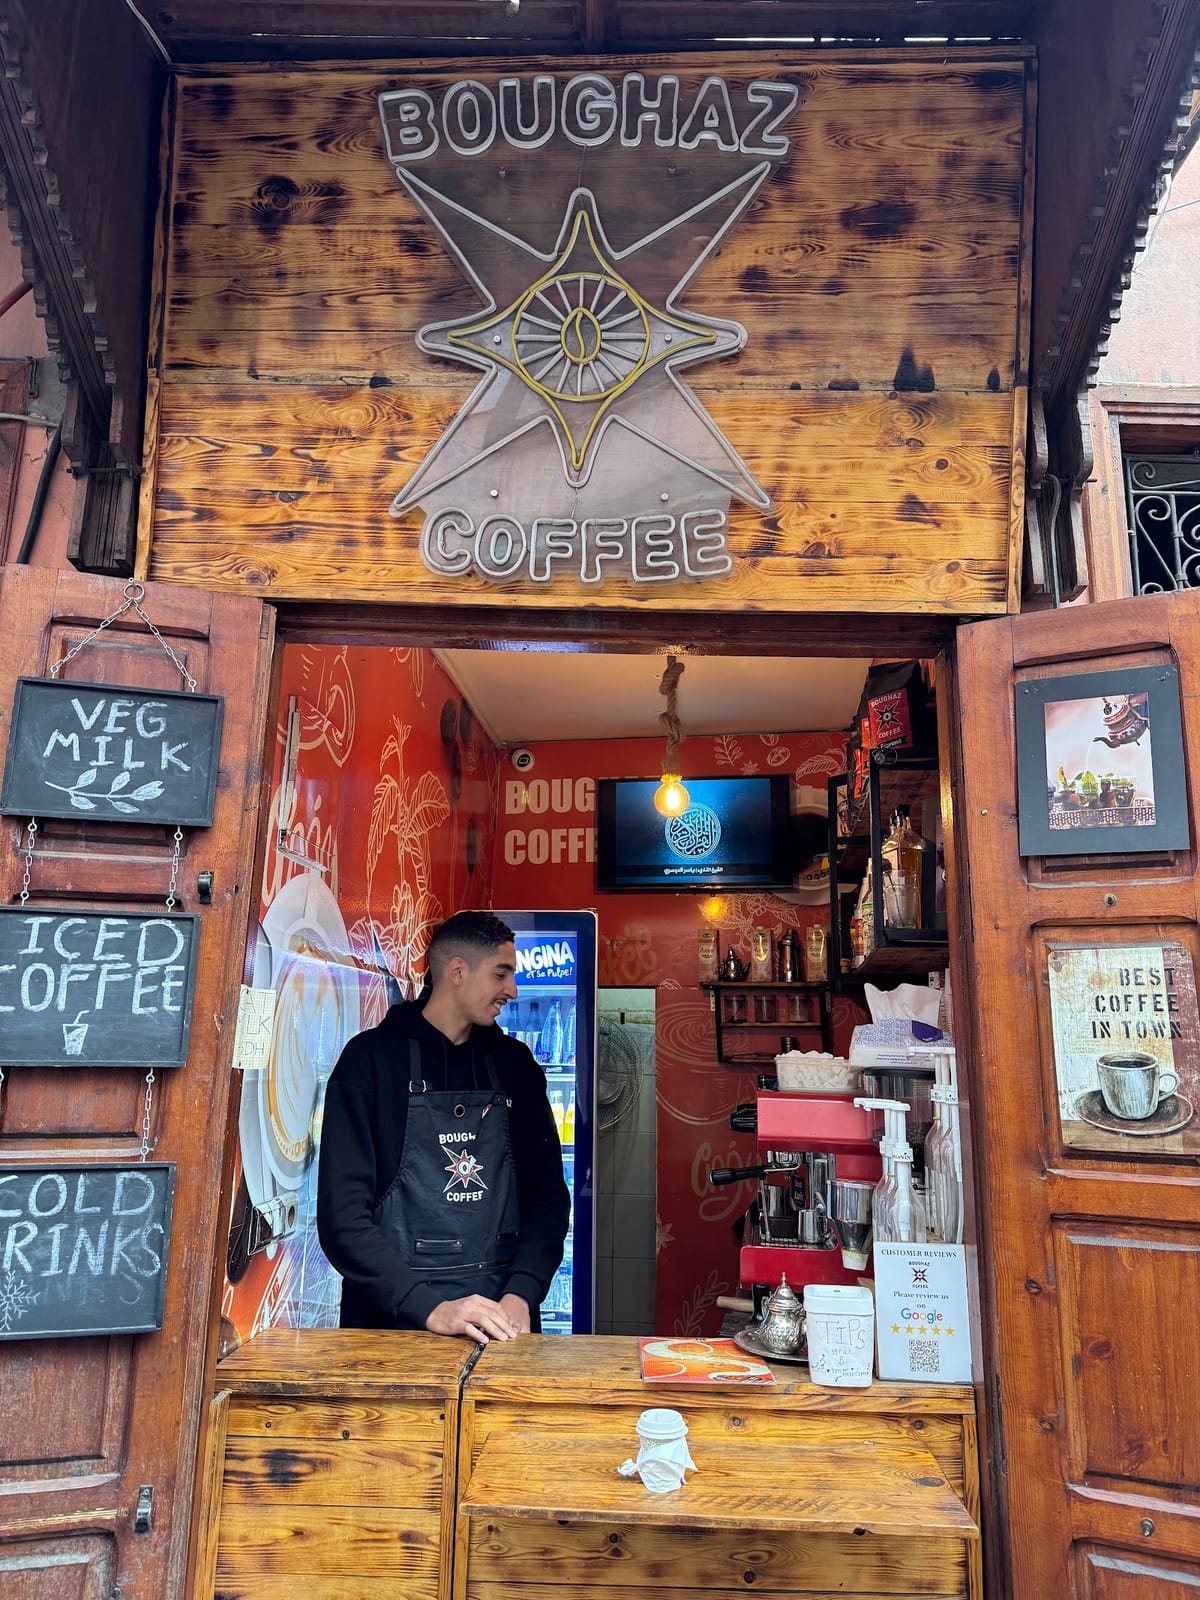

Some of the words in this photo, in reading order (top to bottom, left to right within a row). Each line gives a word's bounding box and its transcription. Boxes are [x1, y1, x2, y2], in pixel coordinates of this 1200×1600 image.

[378, 73, 799, 161] BOUGHAZ
[423, 506, 733, 583] COFFEE
[871, 692, 903, 708] BOUGHAZ
[71, 698, 168, 738] VEG
[878, 726, 902, 739] COFFEE
[42, 729, 191, 771] MILK
[505, 777, 597, 814] BOUG
[17, 917, 184, 966] ICED
[515, 941, 575, 974] NGINA
[1119, 967, 1176, 987] BEST
[1095, 993, 1179, 1013] COFFEE
[1091, 1020, 1112, 1039] IN
[1120, 1020, 1183, 1040] TOWN
[881, 1248, 923, 1257] CUSTOMER
[923, 1250, 958, 1259] REVIEWS
[893, 1290, 915, 1299] Please
[915, 1291, 939, 1300] review
[900, 1307, 944, 1324] Google
